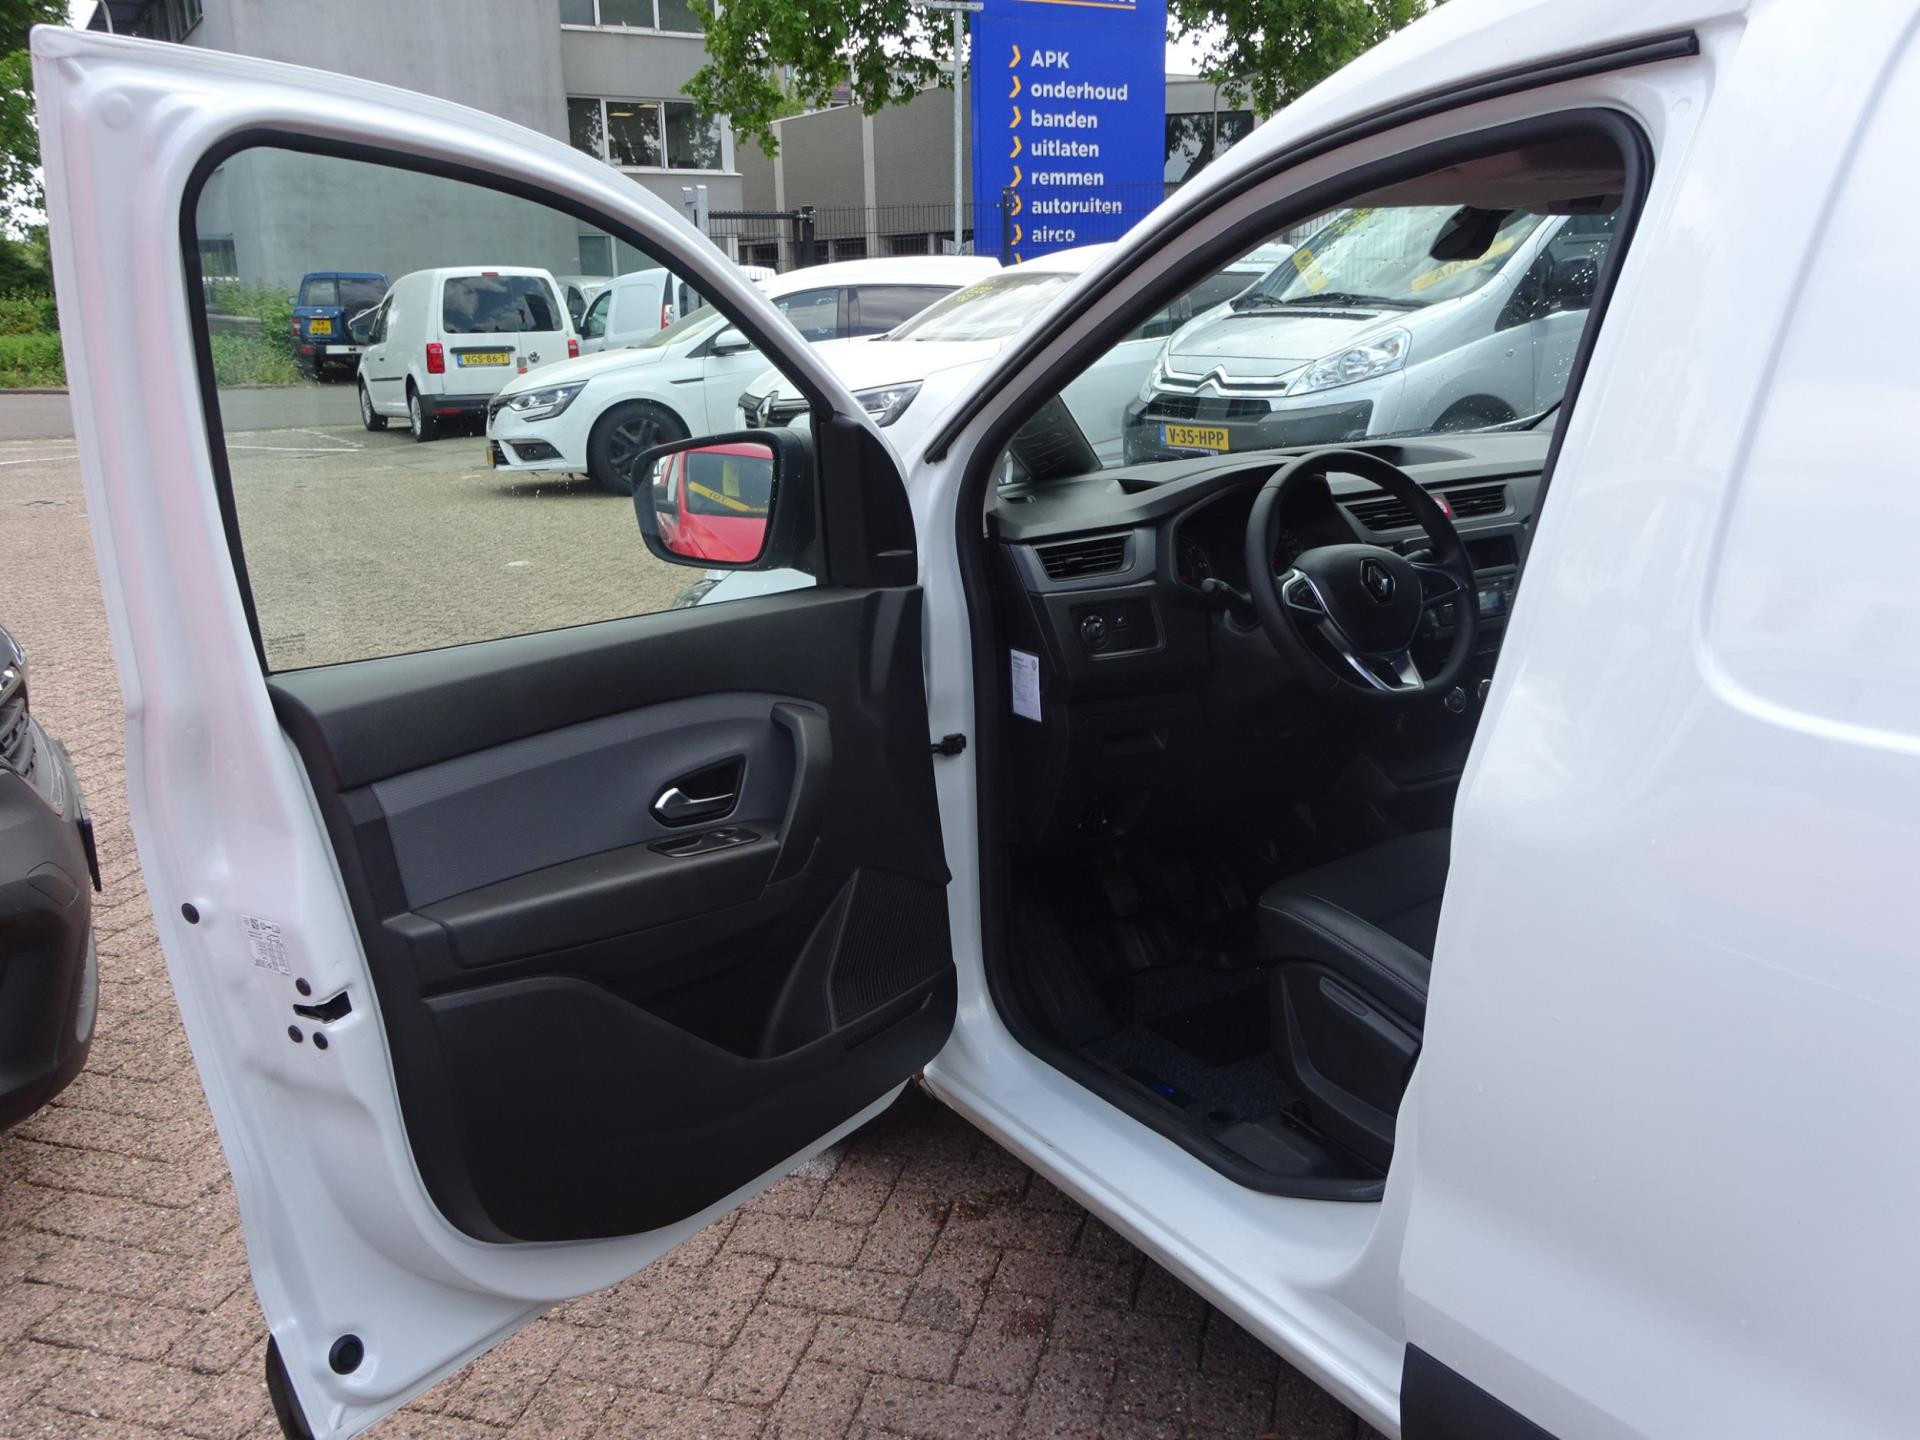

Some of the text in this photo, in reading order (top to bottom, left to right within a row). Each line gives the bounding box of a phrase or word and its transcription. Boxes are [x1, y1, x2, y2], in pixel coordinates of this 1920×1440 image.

[1030, 50, 1070, 69] APK
[1031, 81, 1128, 101] onderhoud
[1031, 109, 1098, 129] banden
[1031, 139, 1100, 158] uitlaten
[1031, 171, 1104, 187] remmen
[1032, 197, 1123, 215] autoruiten
[1032, 225, 1076, 243] airco
[464, 353, 506, 364] VGS-86-T
[1168, 427, 1224, 446] V-35-HPP
